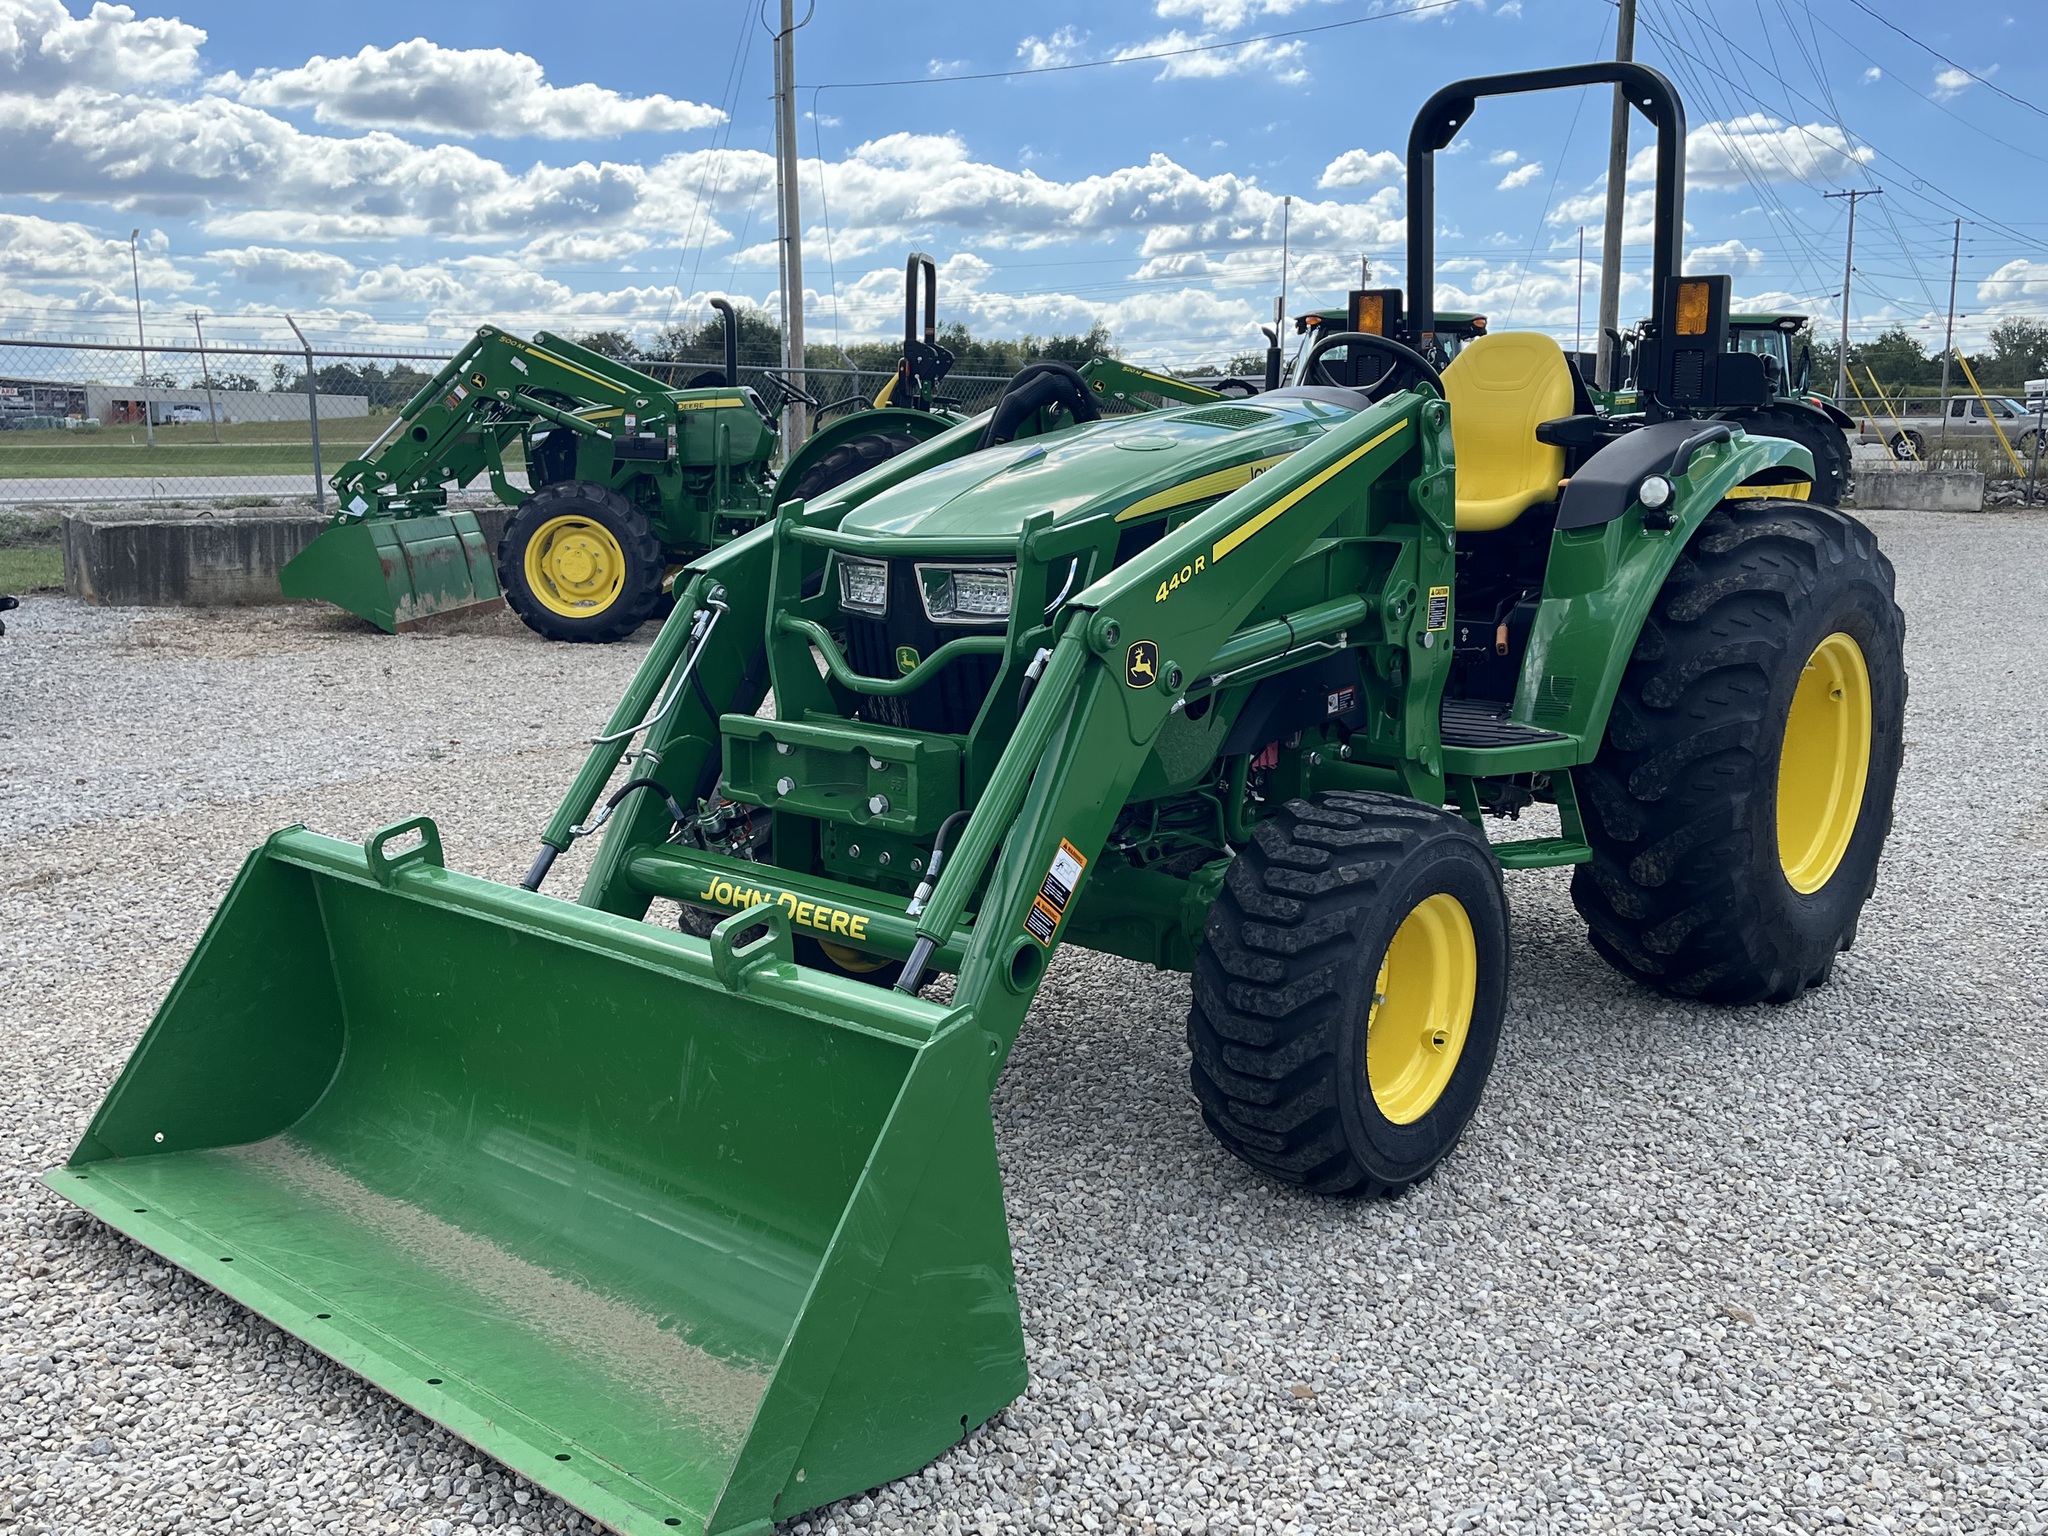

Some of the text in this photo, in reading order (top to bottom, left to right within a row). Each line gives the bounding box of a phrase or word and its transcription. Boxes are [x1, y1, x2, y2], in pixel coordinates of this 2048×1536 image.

[1154, 554, 1206, 603] 440 R
[700, 876, 870, 941] JOHN DEERE
